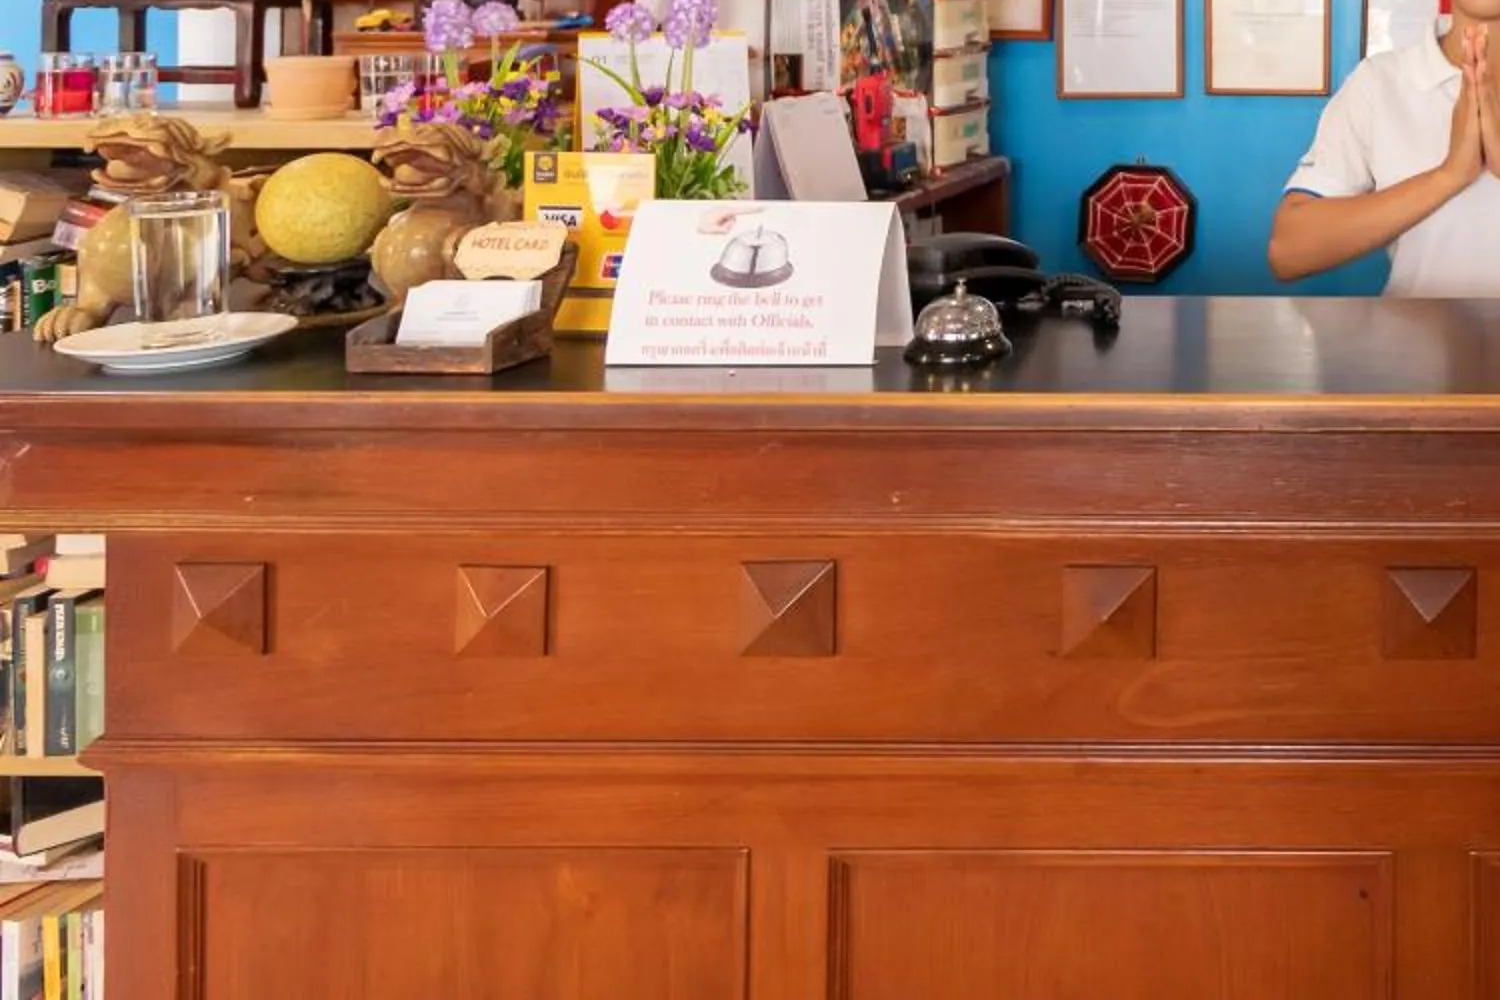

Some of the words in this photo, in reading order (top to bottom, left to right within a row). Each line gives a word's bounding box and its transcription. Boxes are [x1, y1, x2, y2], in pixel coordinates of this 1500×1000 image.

[472, 237, 511, 250] HOTEL
[513, 237, 549, 251] CARD
[648, 290, 692, 306] Please
[697, 293, 726, 309] ring
[727, 291, 749, 306] the
[754, 290, 781, 306] bell
[785, 294, 799, 307] to
[802, 294, 824, 308] get
[645, 316, 659, 328] in
[662, 314, 713, 328] contact
[717, 313, 747, 328] with
